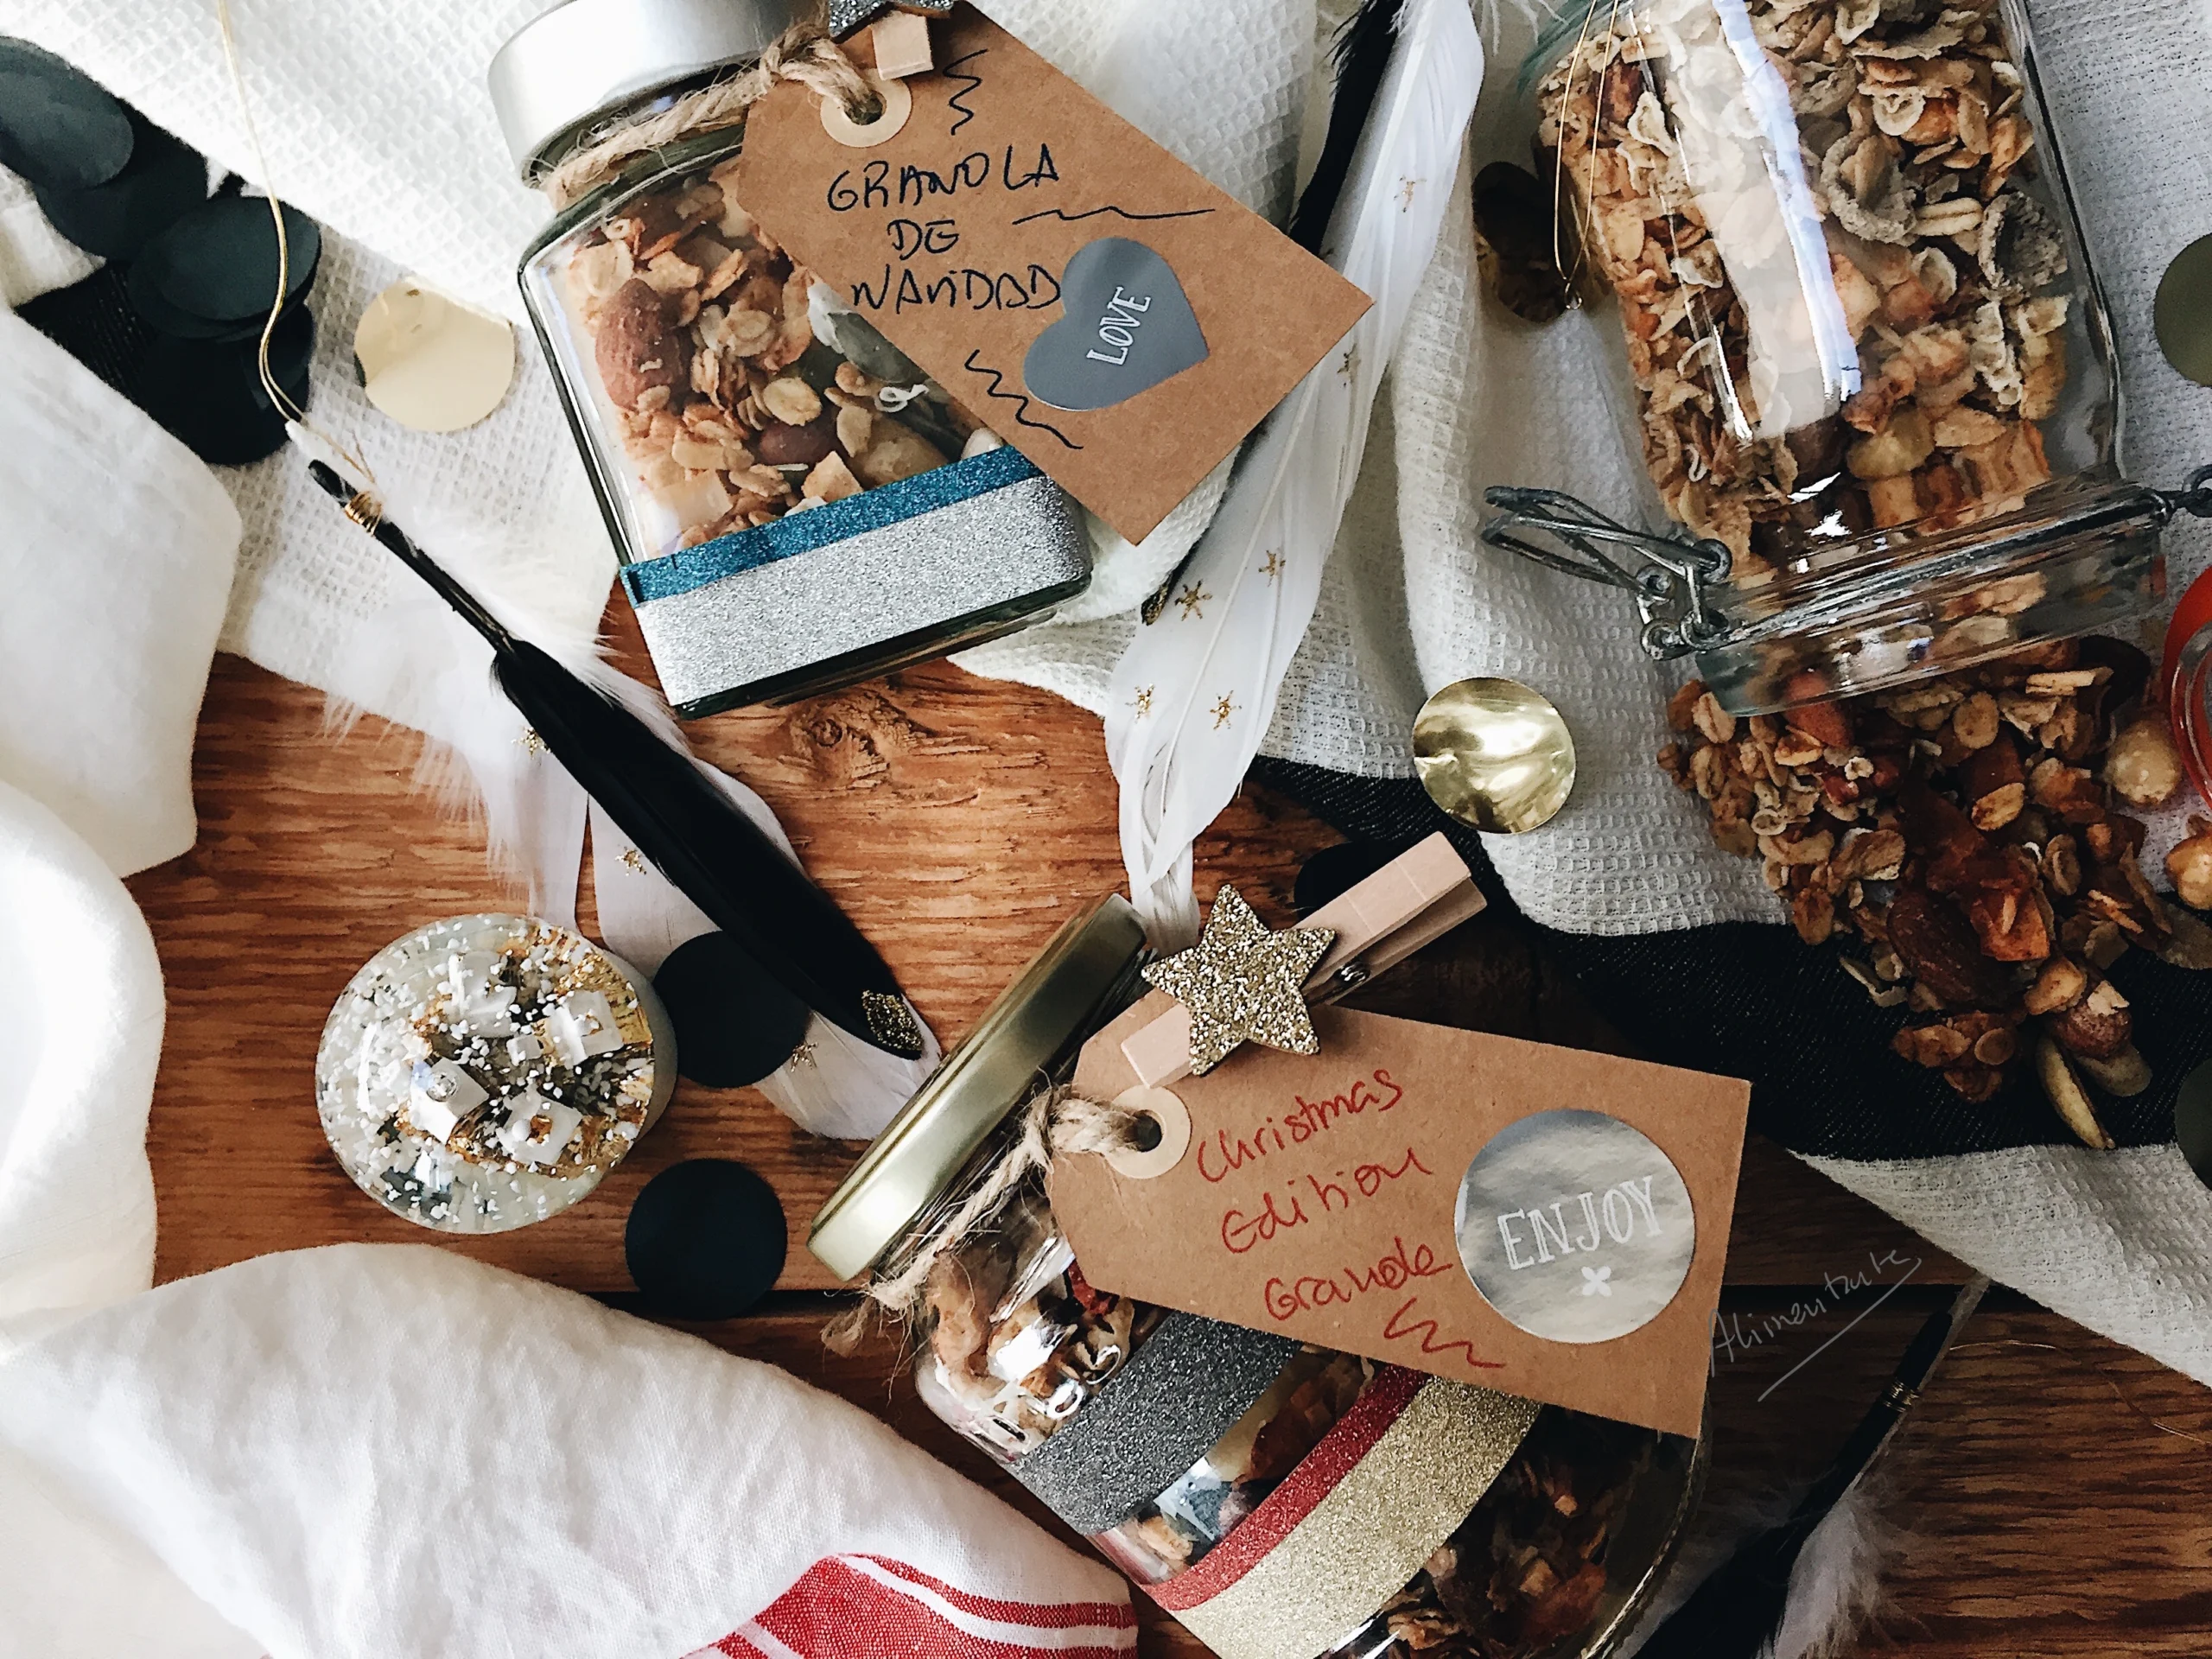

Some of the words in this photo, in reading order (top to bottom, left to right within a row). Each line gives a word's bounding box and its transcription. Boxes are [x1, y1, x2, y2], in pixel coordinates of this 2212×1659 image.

[827, 143, 1059, 212] GRANOLA
[887, 219, 959, 261] DE
[1085, 285, 1152, 365] LOVE
[1197, 1068, 1404, 1183] Christmas
[1221, 1147, 1433, 1254] Edition
[1497, 1174, 1664, 1271] ENJOY
[1264, 1235, 1454, 1321] Grande
